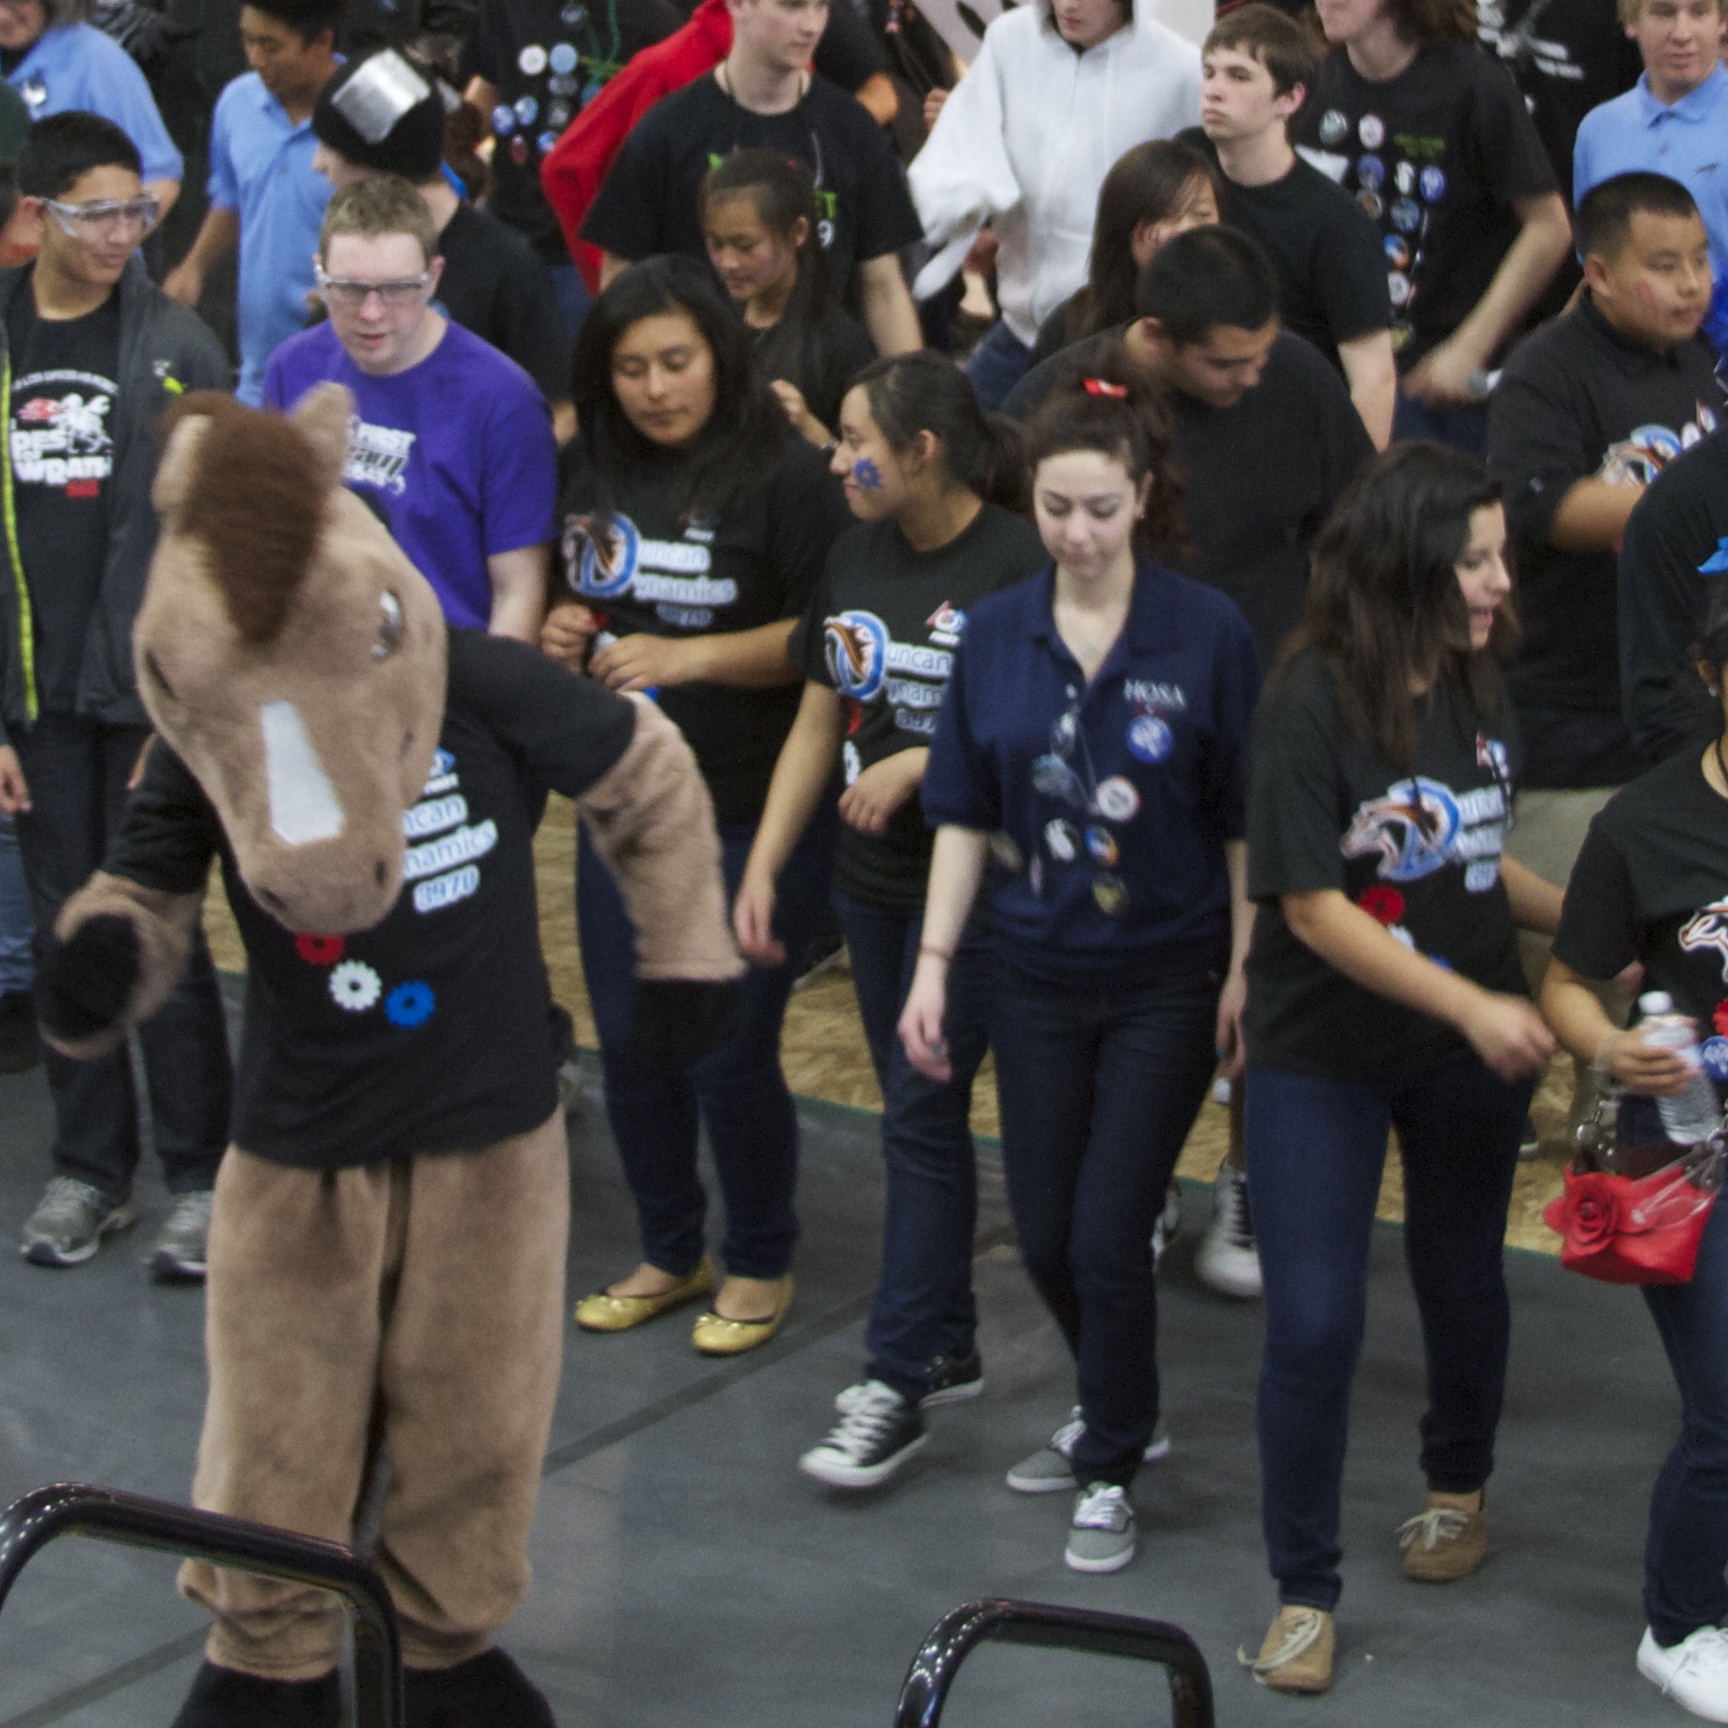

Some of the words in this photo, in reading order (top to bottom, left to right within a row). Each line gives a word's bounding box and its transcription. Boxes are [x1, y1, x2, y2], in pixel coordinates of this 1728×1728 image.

[403, 793, 470, 840] ncan
[402, 819, 498, 880] namics
[415, 865, 480, 914] 3970
